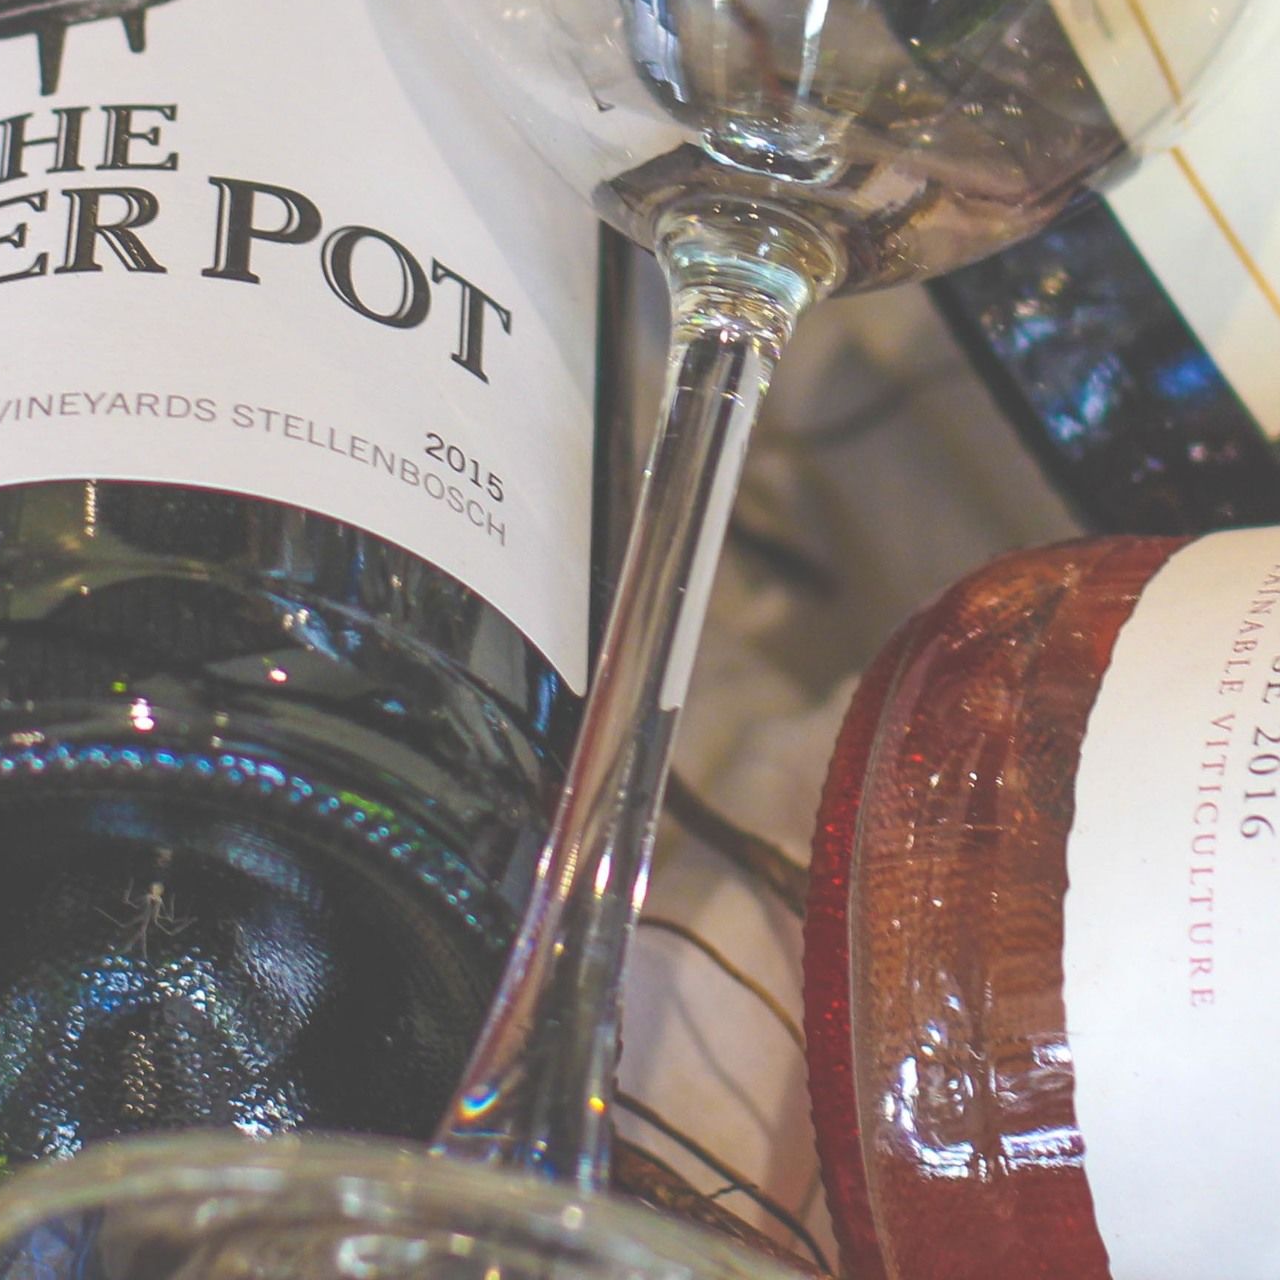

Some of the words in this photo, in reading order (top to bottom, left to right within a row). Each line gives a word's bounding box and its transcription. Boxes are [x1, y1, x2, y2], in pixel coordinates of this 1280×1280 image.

[201, 176, 512, 384] POT
[230, 403, 507, 547] STELLENBOSCH
[424, 432, 506, 503] 2015
[1187, 711, 1237, 1009] VITICULTURE
